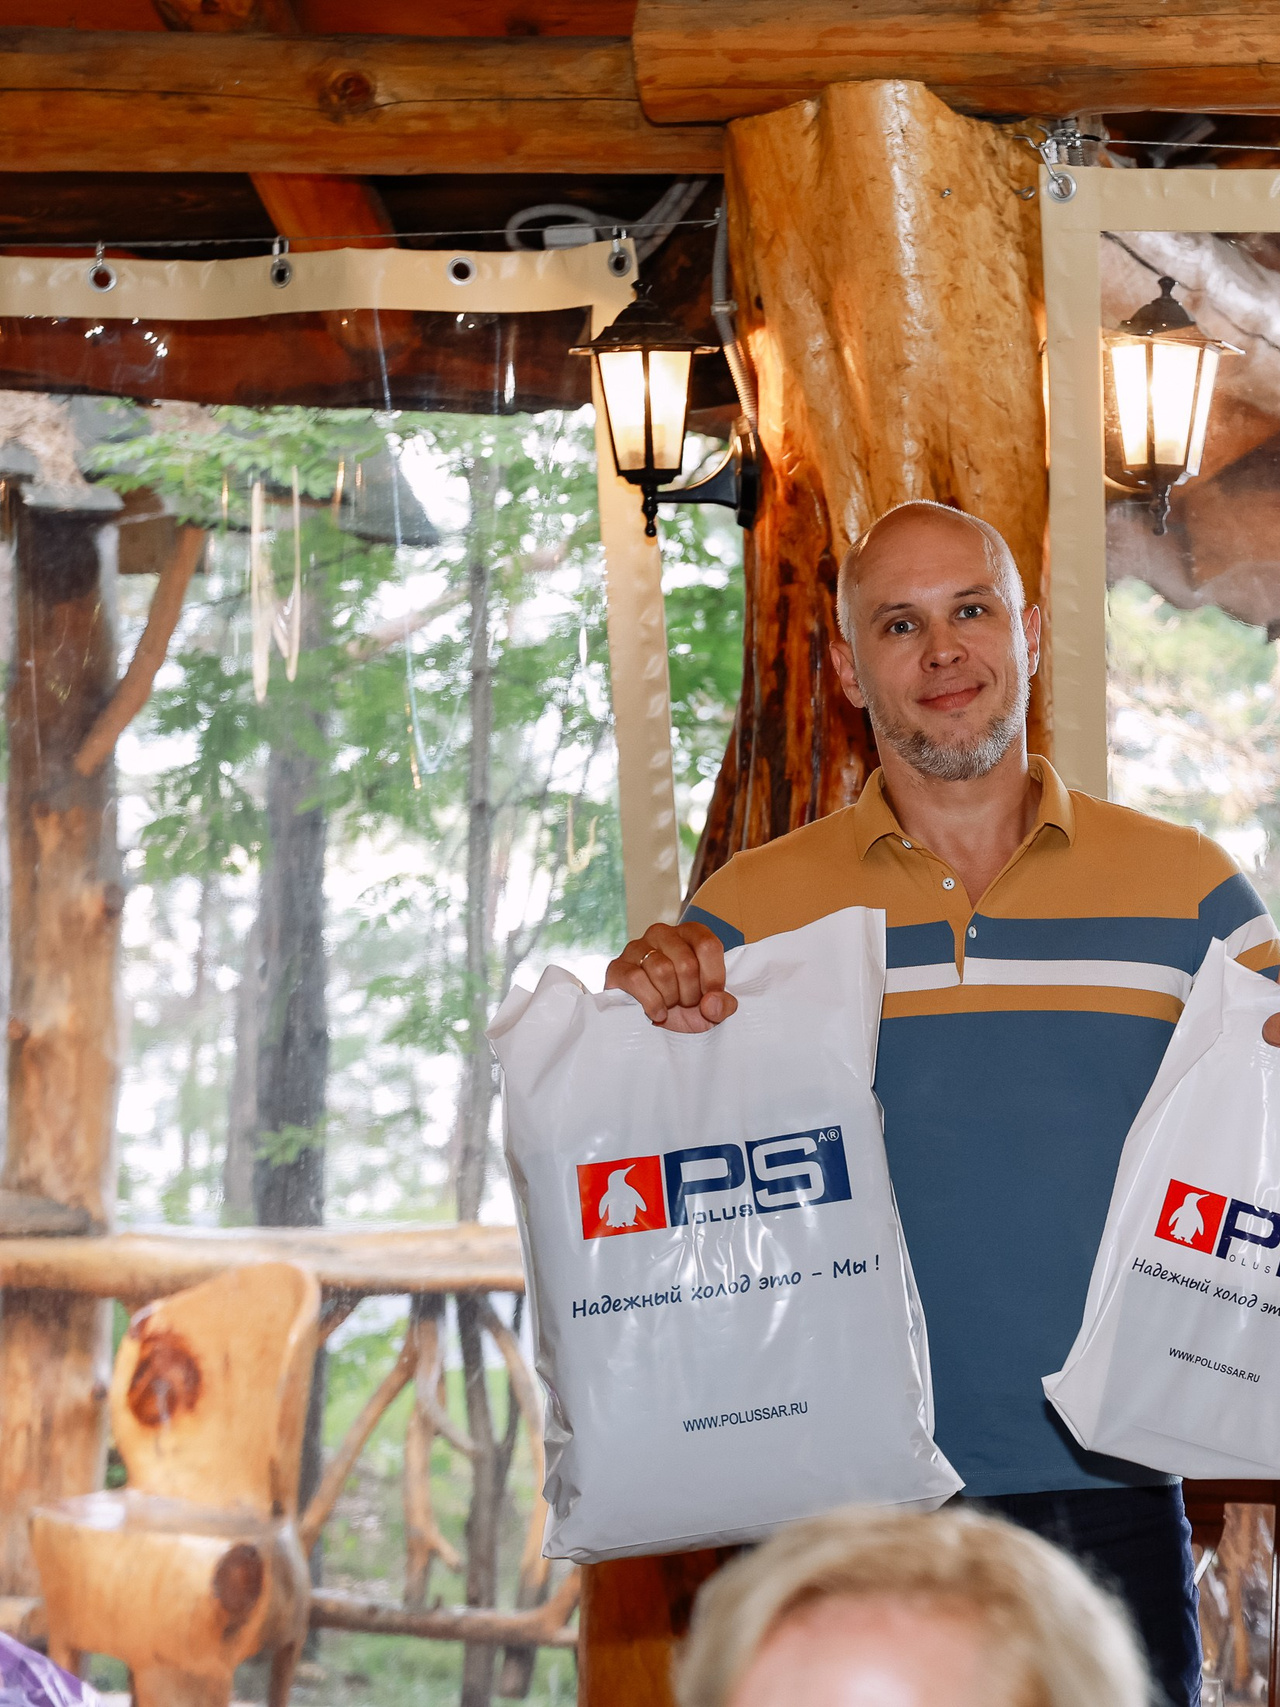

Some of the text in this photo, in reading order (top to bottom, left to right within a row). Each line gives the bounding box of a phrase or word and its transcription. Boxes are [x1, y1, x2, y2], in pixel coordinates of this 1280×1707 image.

[1228, 1254, 1271, 1274] OLUS
[572, 1285, 683, 1318] Надежный
[691, 1273, 751, 1302] холод
[758, 1271, 802, 1290] это
[1131, 1257, 1211, 1294] Надежный
[1213, 1286, 1258, 1308] холод
[1169, 1347, 1261, 1383] WWW.POLUSSAR.RU
[682, 1401, 808, 1433] WWW.POLUSSAR.RU
